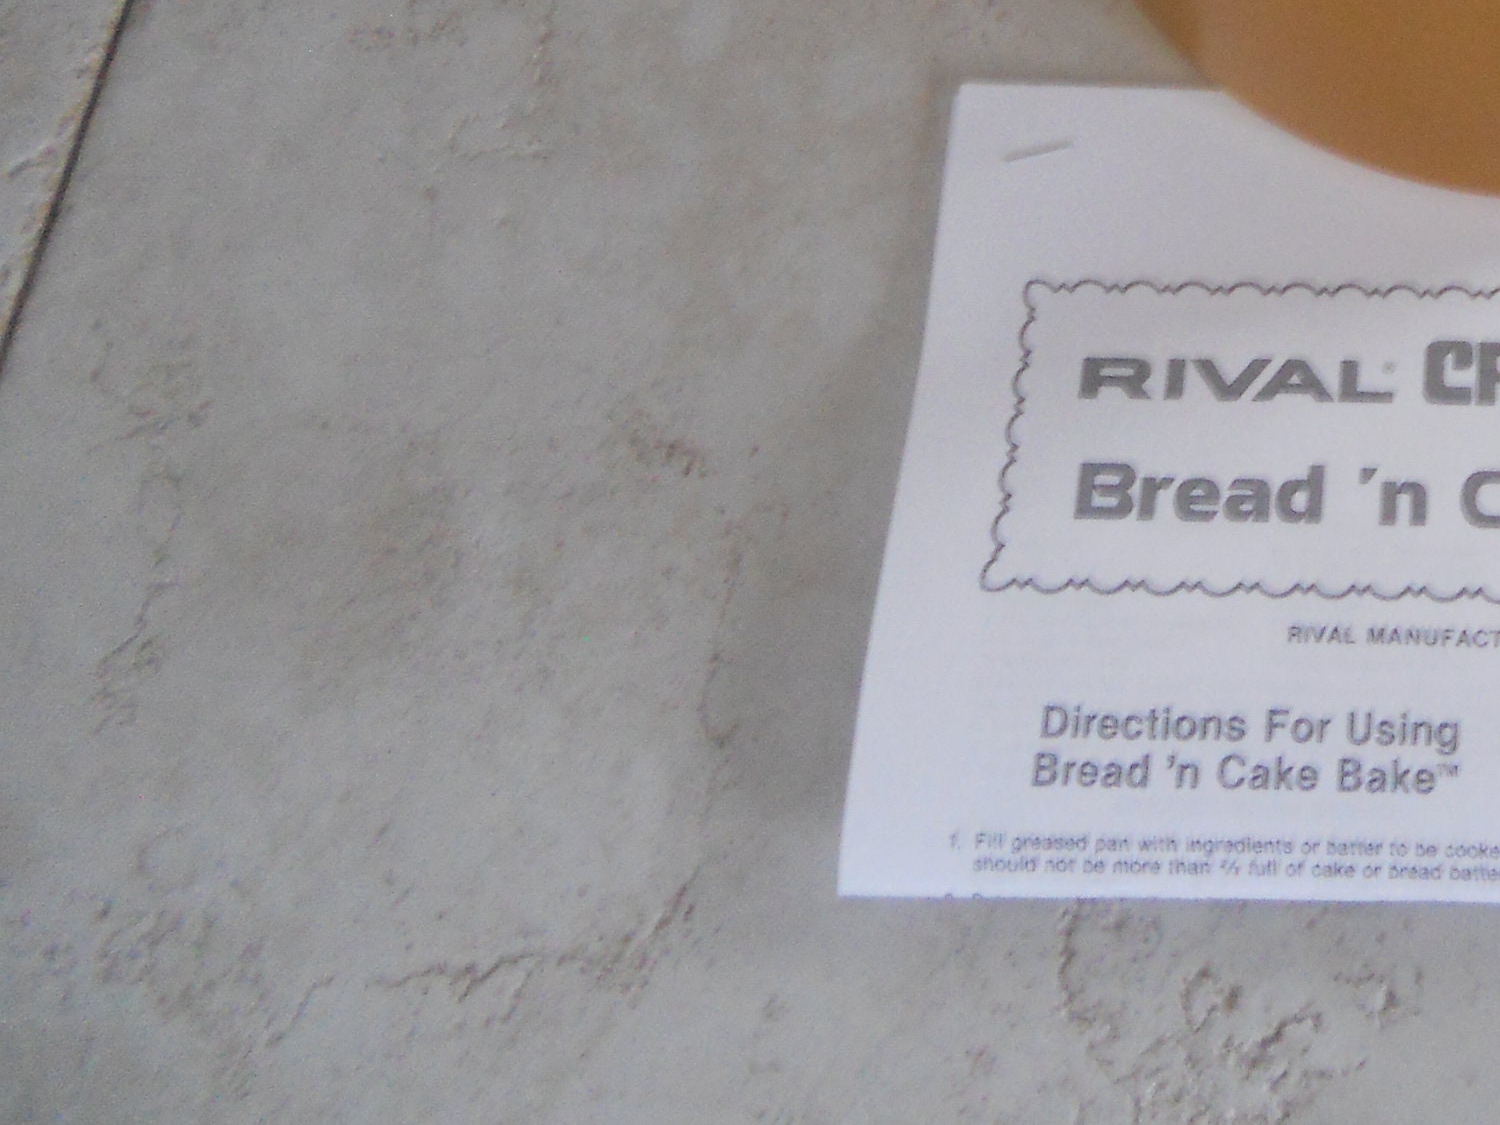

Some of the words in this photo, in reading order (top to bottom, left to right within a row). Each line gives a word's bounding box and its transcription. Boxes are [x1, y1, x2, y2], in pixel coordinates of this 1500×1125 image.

[1078, 356, 1394, 404] RIVAL
[1073, 462, 1326, 525] Bread
[1287, 625, 1356, 645] RIVAL
[1039, 704, 1247, 743] Directions
[1263, 709, 1331, 744] For
[1346, 712, 1461, 755] Using
[1031, 753, 1151, 789] Bread
[1215, 755, 1319, 792] Cake
[974, 832, 1004, 850] Fill
[1011, 831, 1090, 854] greased
[1095, 836, 1131, 855] pan
[1138, 833, 1178, 852] with
[1186, 834, 1293, 858] ingredients
[1301, 840, 1321, 854] or
[1327, 837, 1384, 856] batter
[1390, 839, 1408, 857] to
[1414, 838, 1438, 857] be
[973, 854, 1038, 873] should
[1045, 857, 1075, 873] not
[1082, 855, 1105, 873] be
[1112, 859, 1160, 874] more
[1168, 857, 1211, 875] than
[1248, 858, 1278, 876] full
[1285, 858, 1305, 876] of
[1311, 860, 1355, 878] cake
[1362, 863, 1382, 878] or
[1388, 861, 1442, 879] bread
